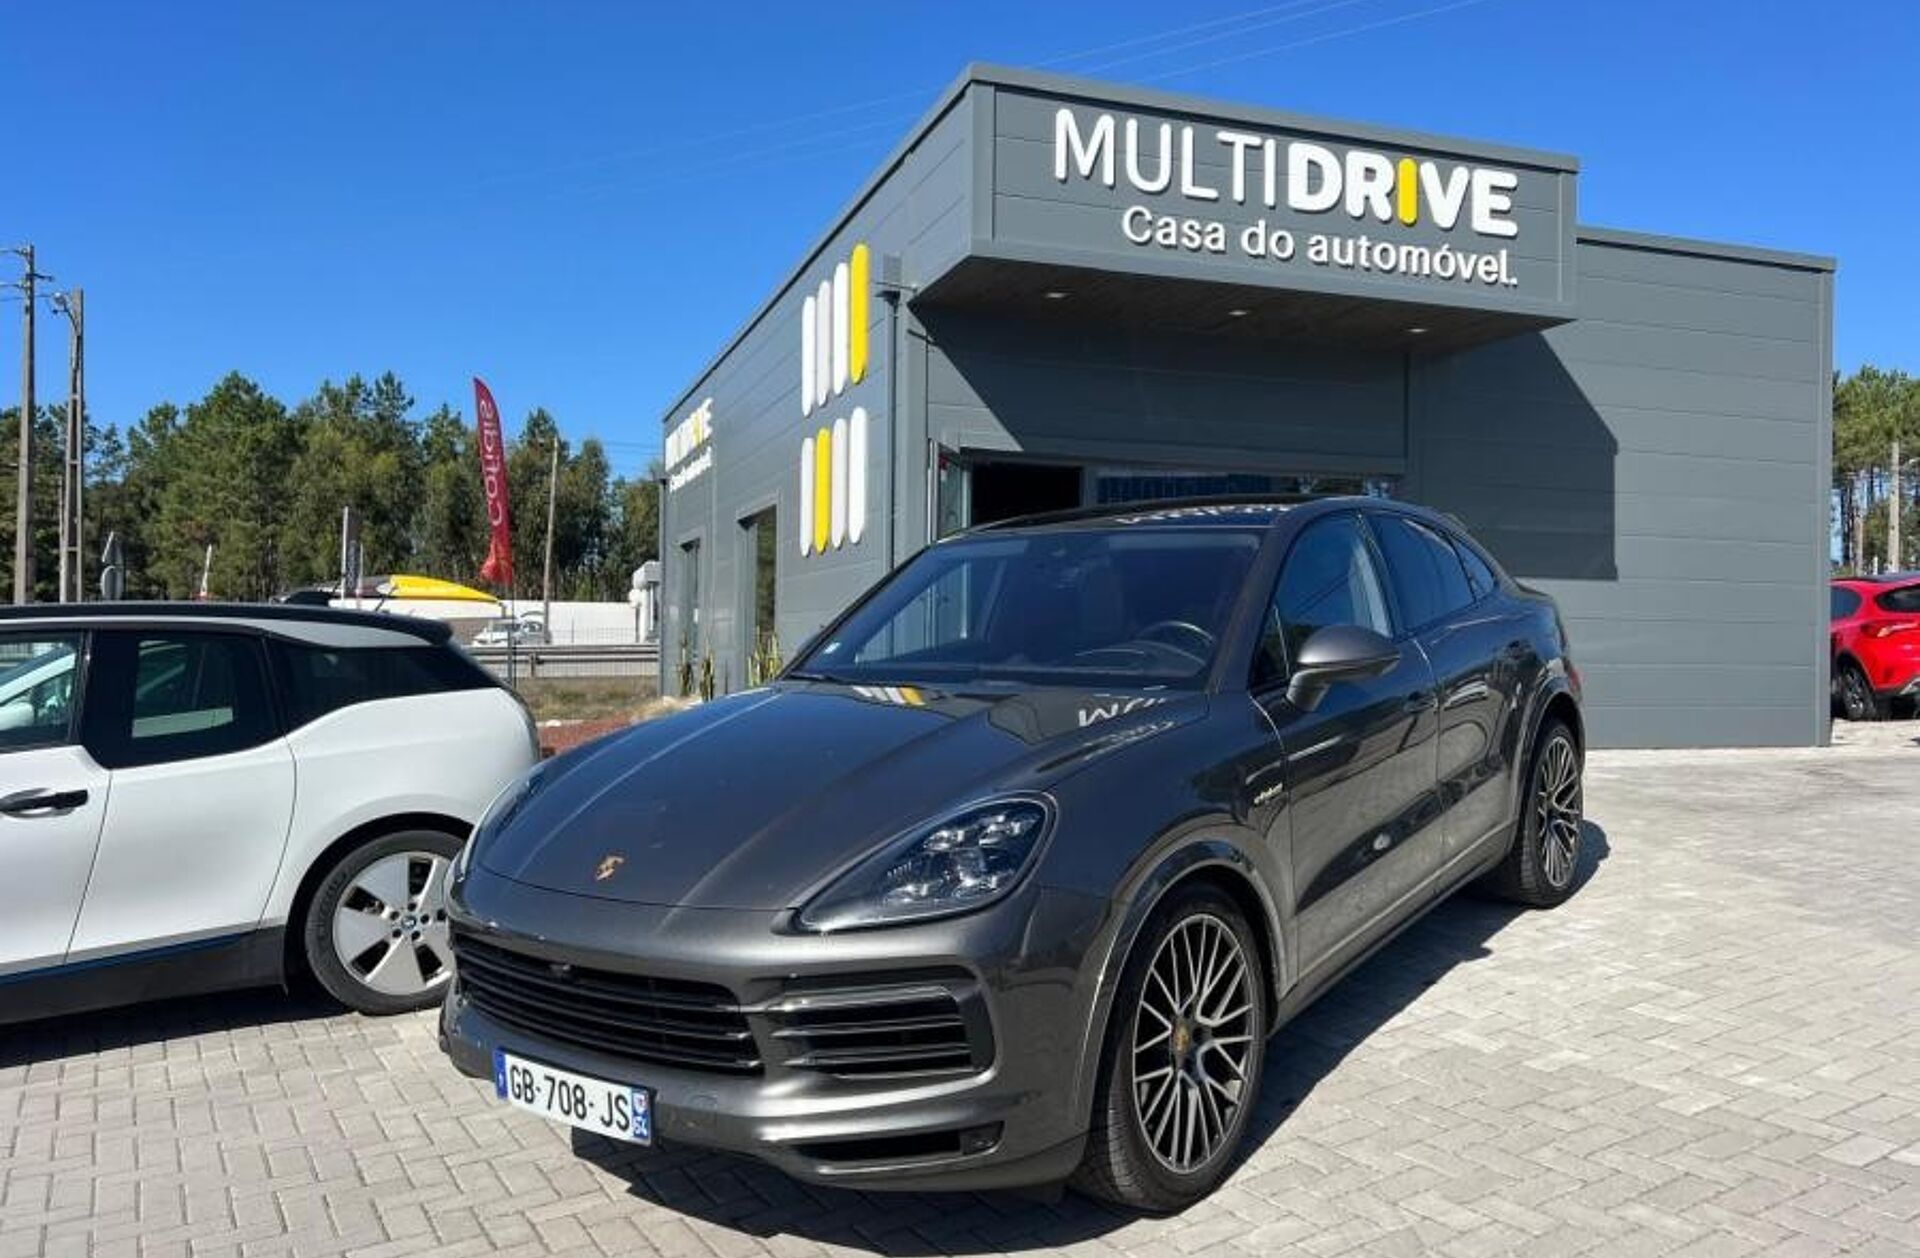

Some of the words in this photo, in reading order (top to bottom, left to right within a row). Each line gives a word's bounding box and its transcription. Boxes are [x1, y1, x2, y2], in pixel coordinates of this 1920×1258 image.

[1055, 108, 1518, 236] MULTIDRIVE
[1122, 205, 1227, 252] Casa
[1241, 219, 1295, 260] do
[1307, 232, 1518, 286] automóvel.
